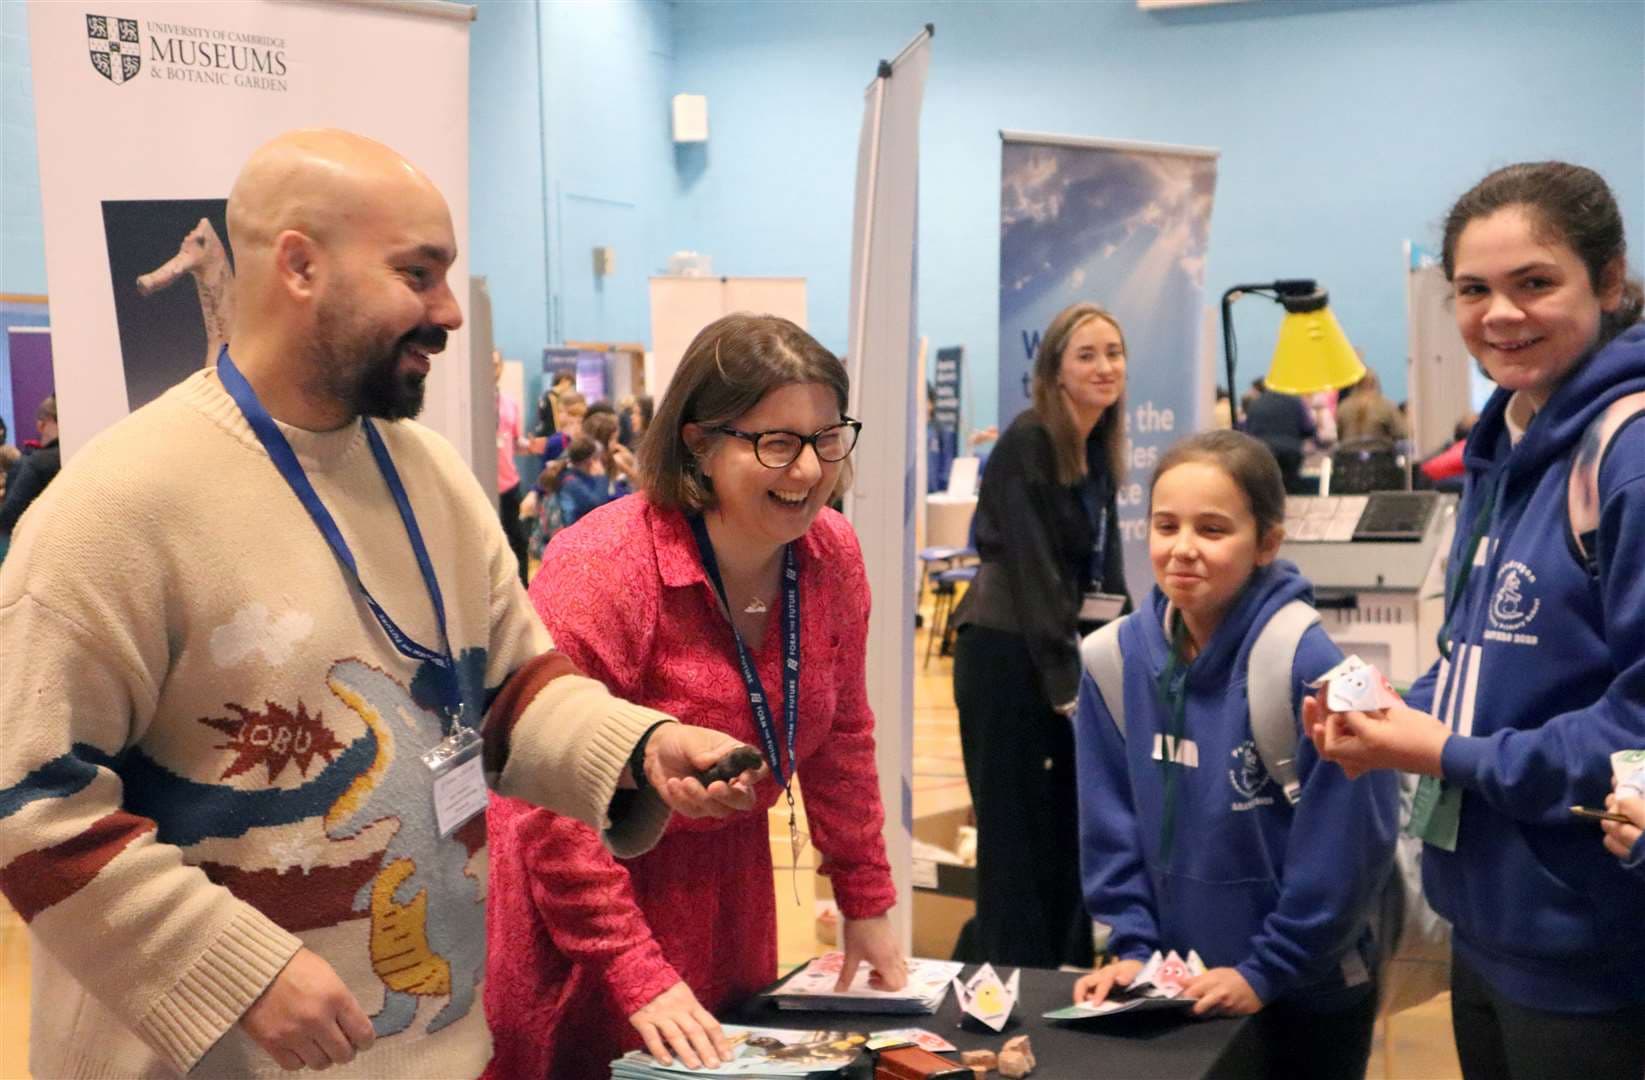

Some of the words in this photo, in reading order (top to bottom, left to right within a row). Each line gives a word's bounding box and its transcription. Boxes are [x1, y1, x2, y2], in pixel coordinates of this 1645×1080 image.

[147, 21, 211, 39] UNIVERSITY
[213, 30, 226, 41] OF
[228, 31, 285, 49] CAMBRIDGE
[150, 36, 287, 76] MUSEUMS
[151, 67, 161, 79] &
[167, 67, 229, 86] BOTANIC
[234, 74, 287, 91] GARDEN
[1136, 401, 1174, 432] the
[788, 590, 796, 618] FUTURE
[789, 633, 797, 656] FORM
